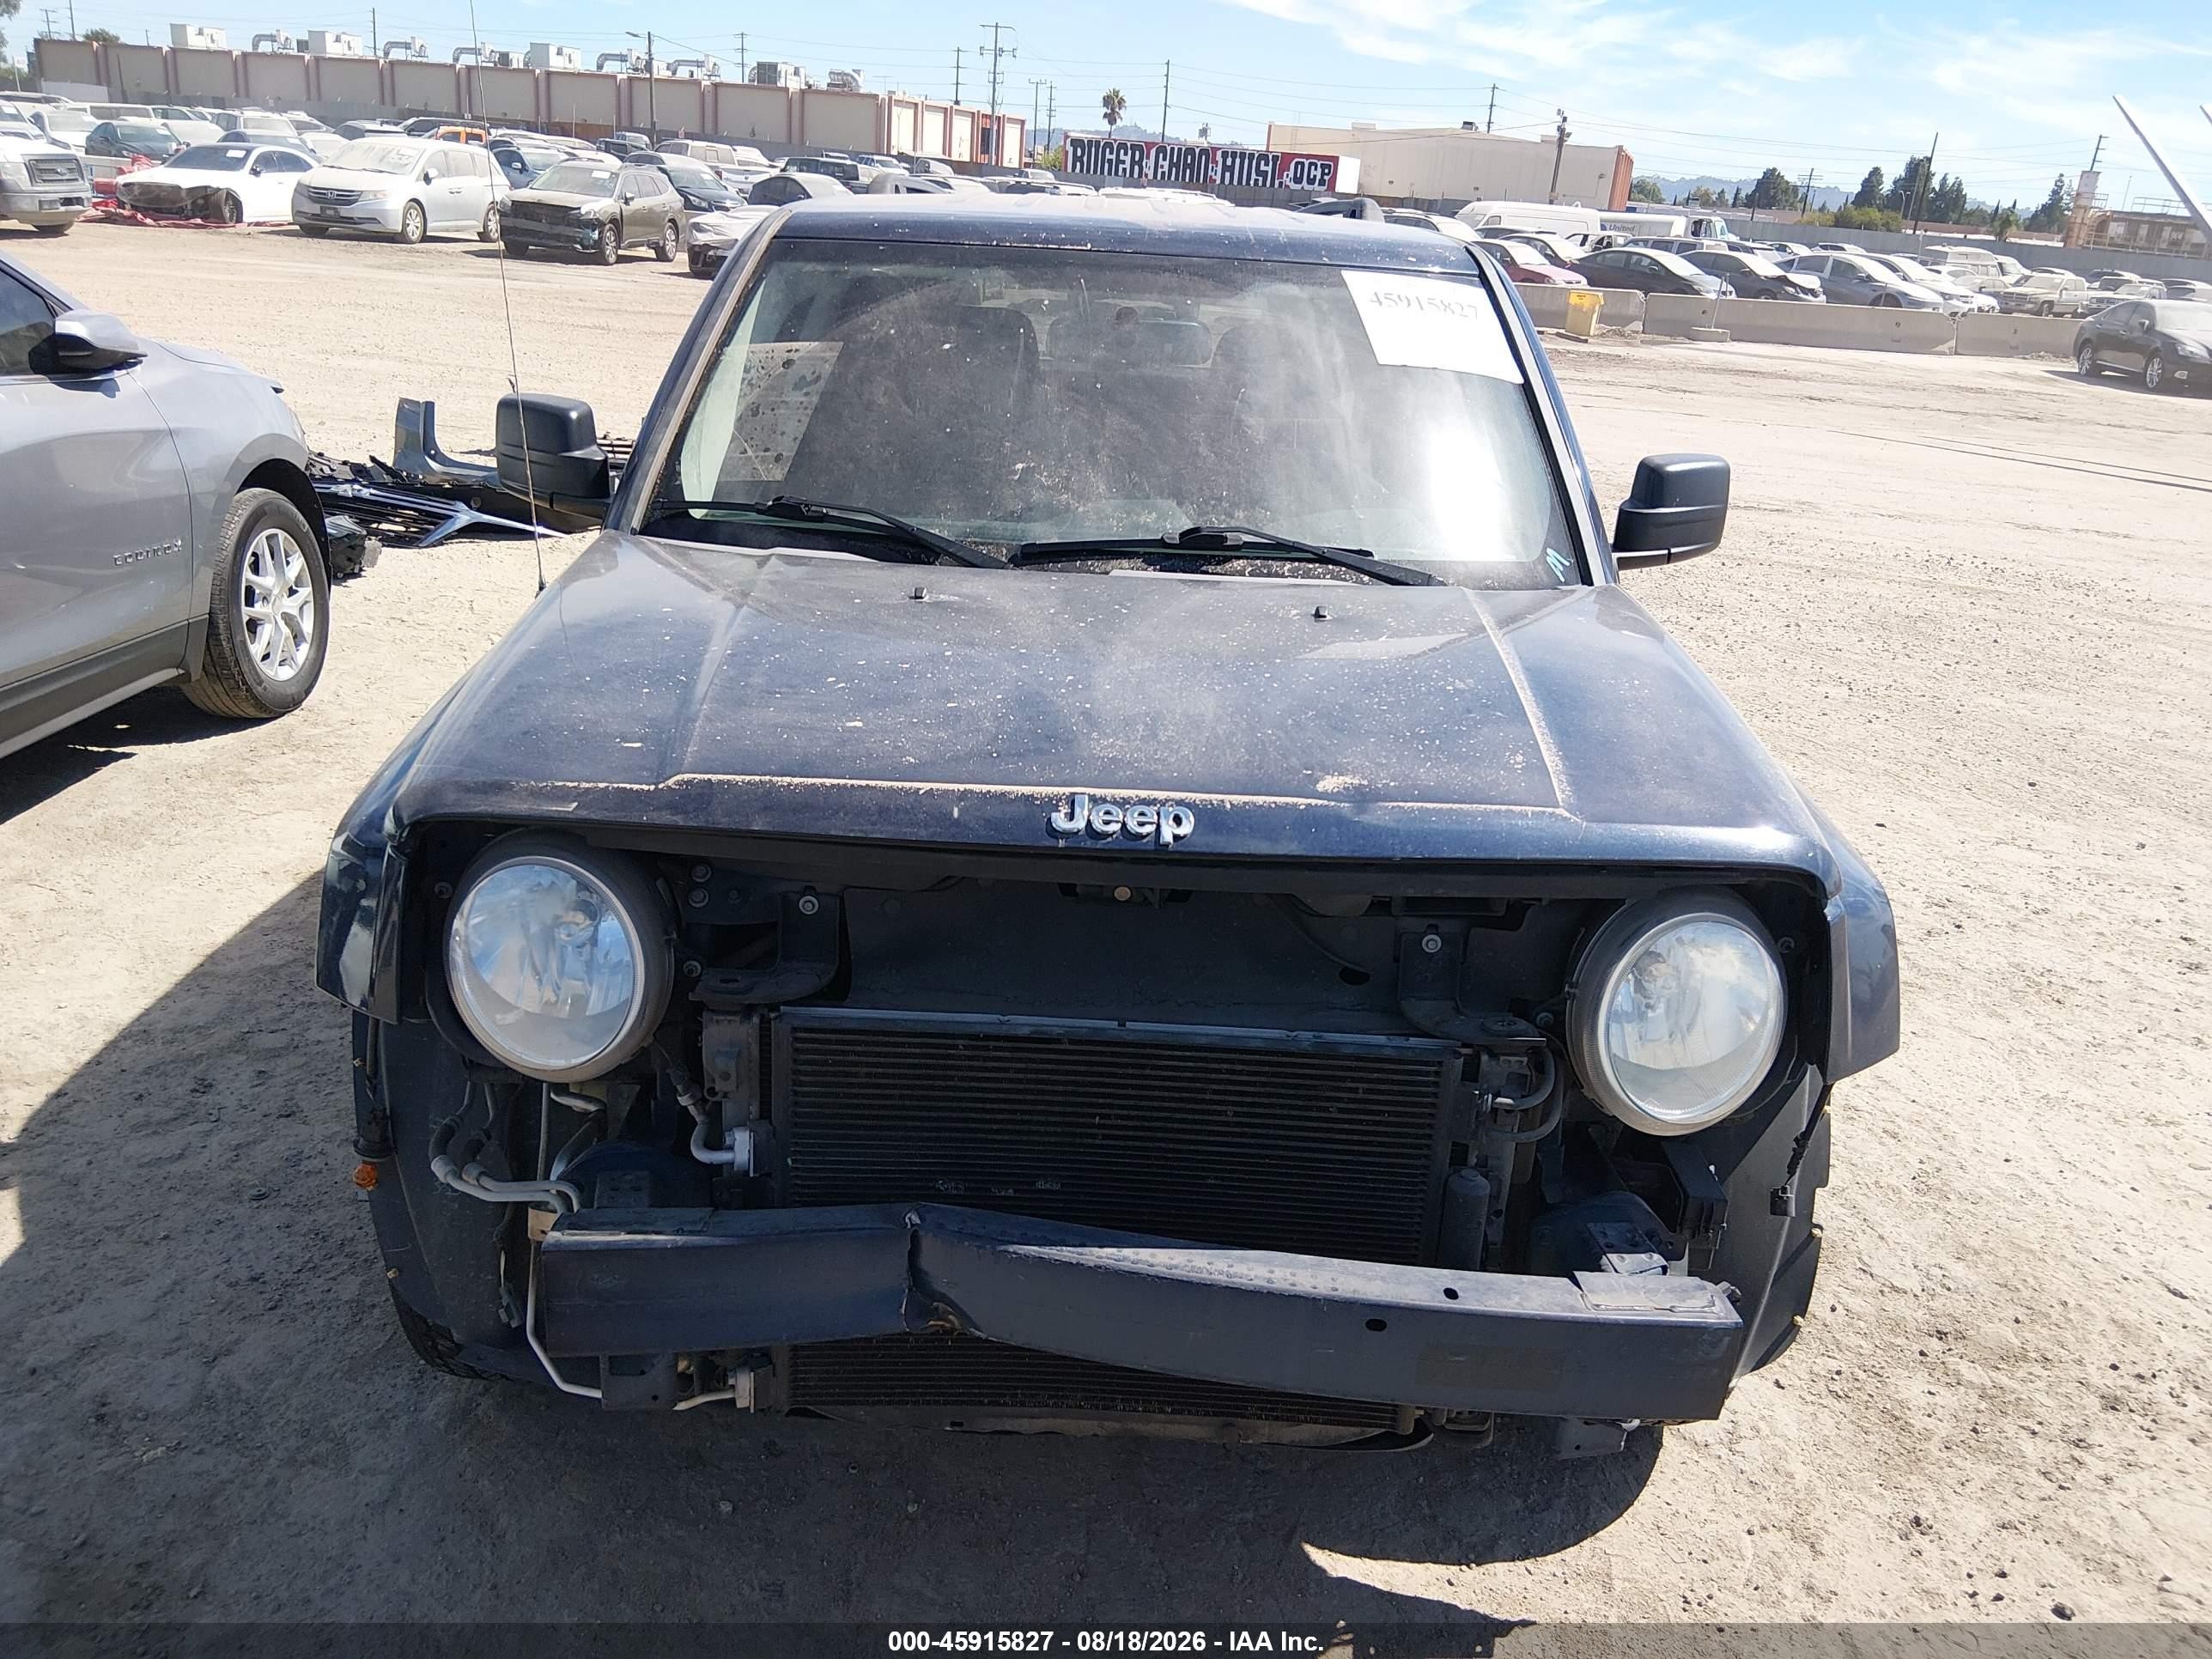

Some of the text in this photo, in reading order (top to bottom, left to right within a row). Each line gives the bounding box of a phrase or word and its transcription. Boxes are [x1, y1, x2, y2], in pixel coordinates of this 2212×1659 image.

[1067, 137, 1146, 179] RUGER
[1151, 143, 1212, 183] CHAN
[1291, 160, 1333, 190] OCP
[1608, 223, 1636, 233] United
[1370, 290, 1478, 320] 45915827
[112, 539, 182, 566] EQUINOX
[1050, 793, 1195, 847] Jeep
